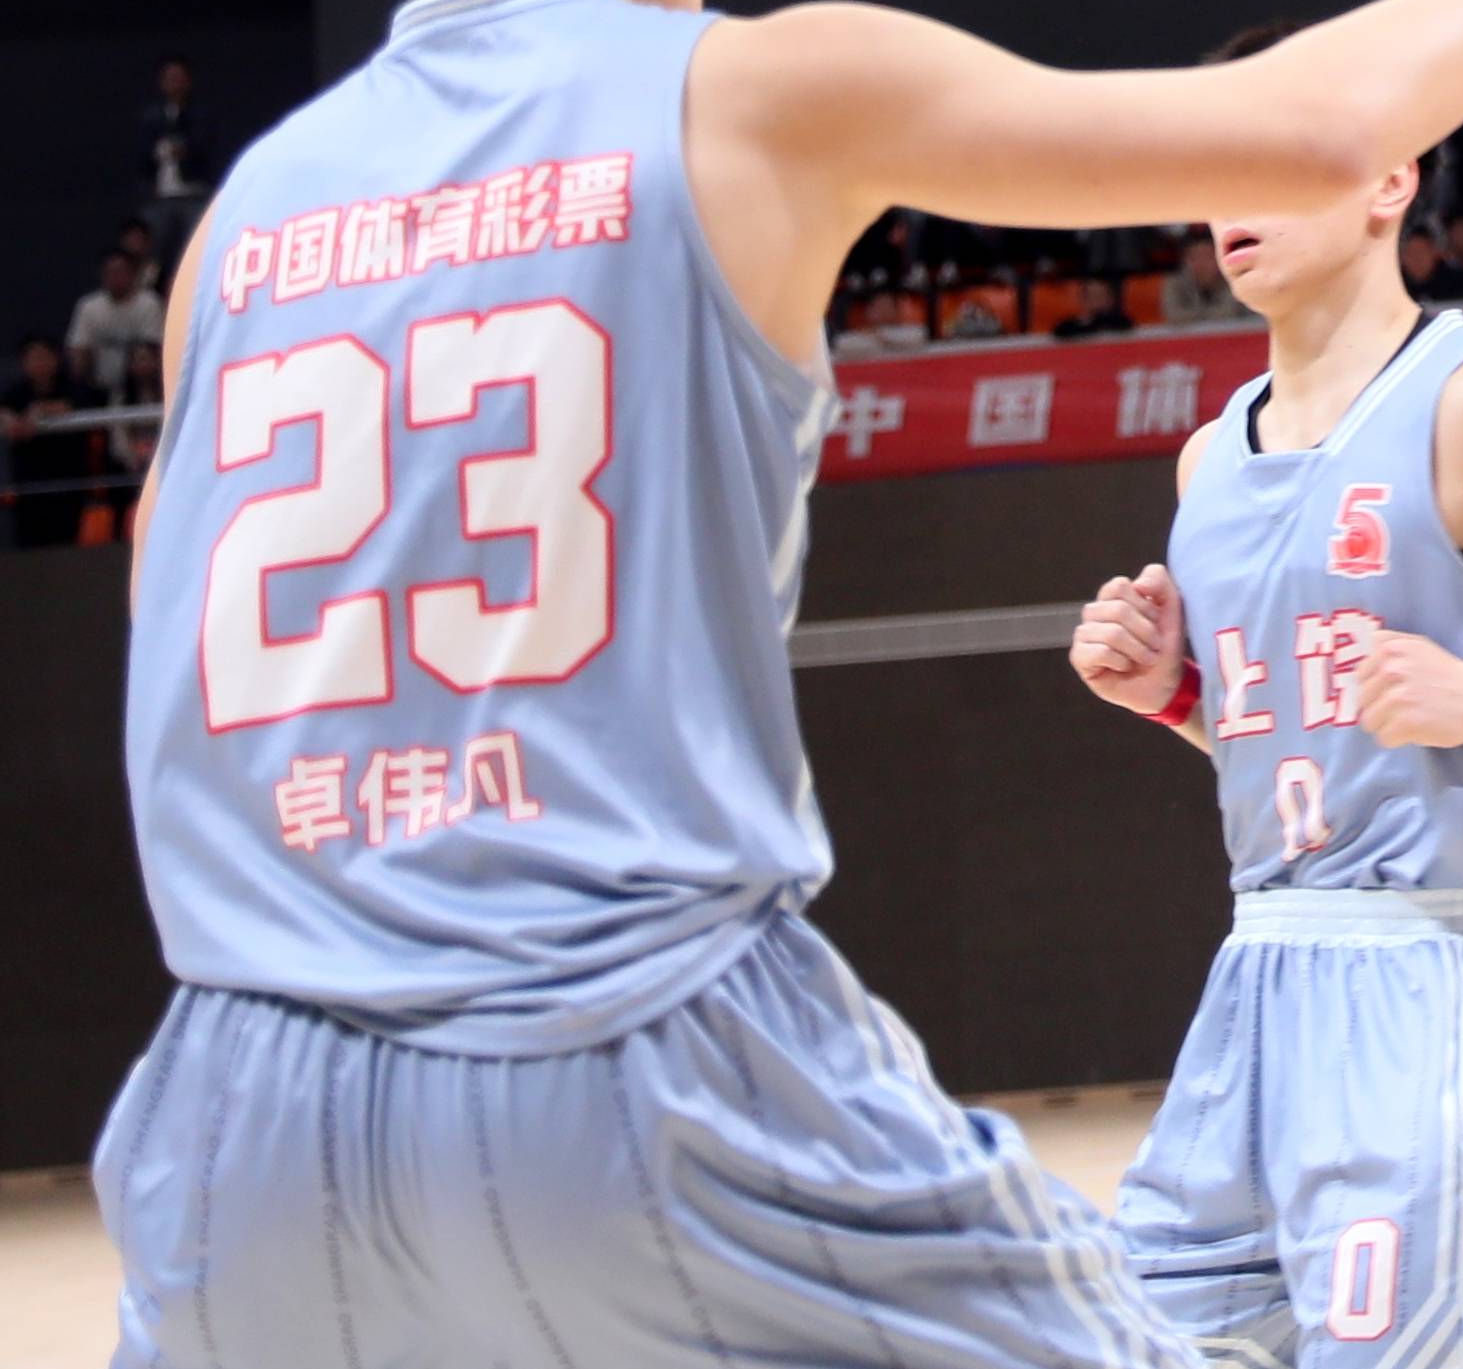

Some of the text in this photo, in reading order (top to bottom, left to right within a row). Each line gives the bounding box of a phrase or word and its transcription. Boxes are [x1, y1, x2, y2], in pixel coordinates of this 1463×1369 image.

[219, 151, 635, 314] 中国体育彩票
[199, 297, 615, 735] 23
[272, 729, 543, 852] 卓伟凡
[1327, 1217, 1401, 1343] 0
